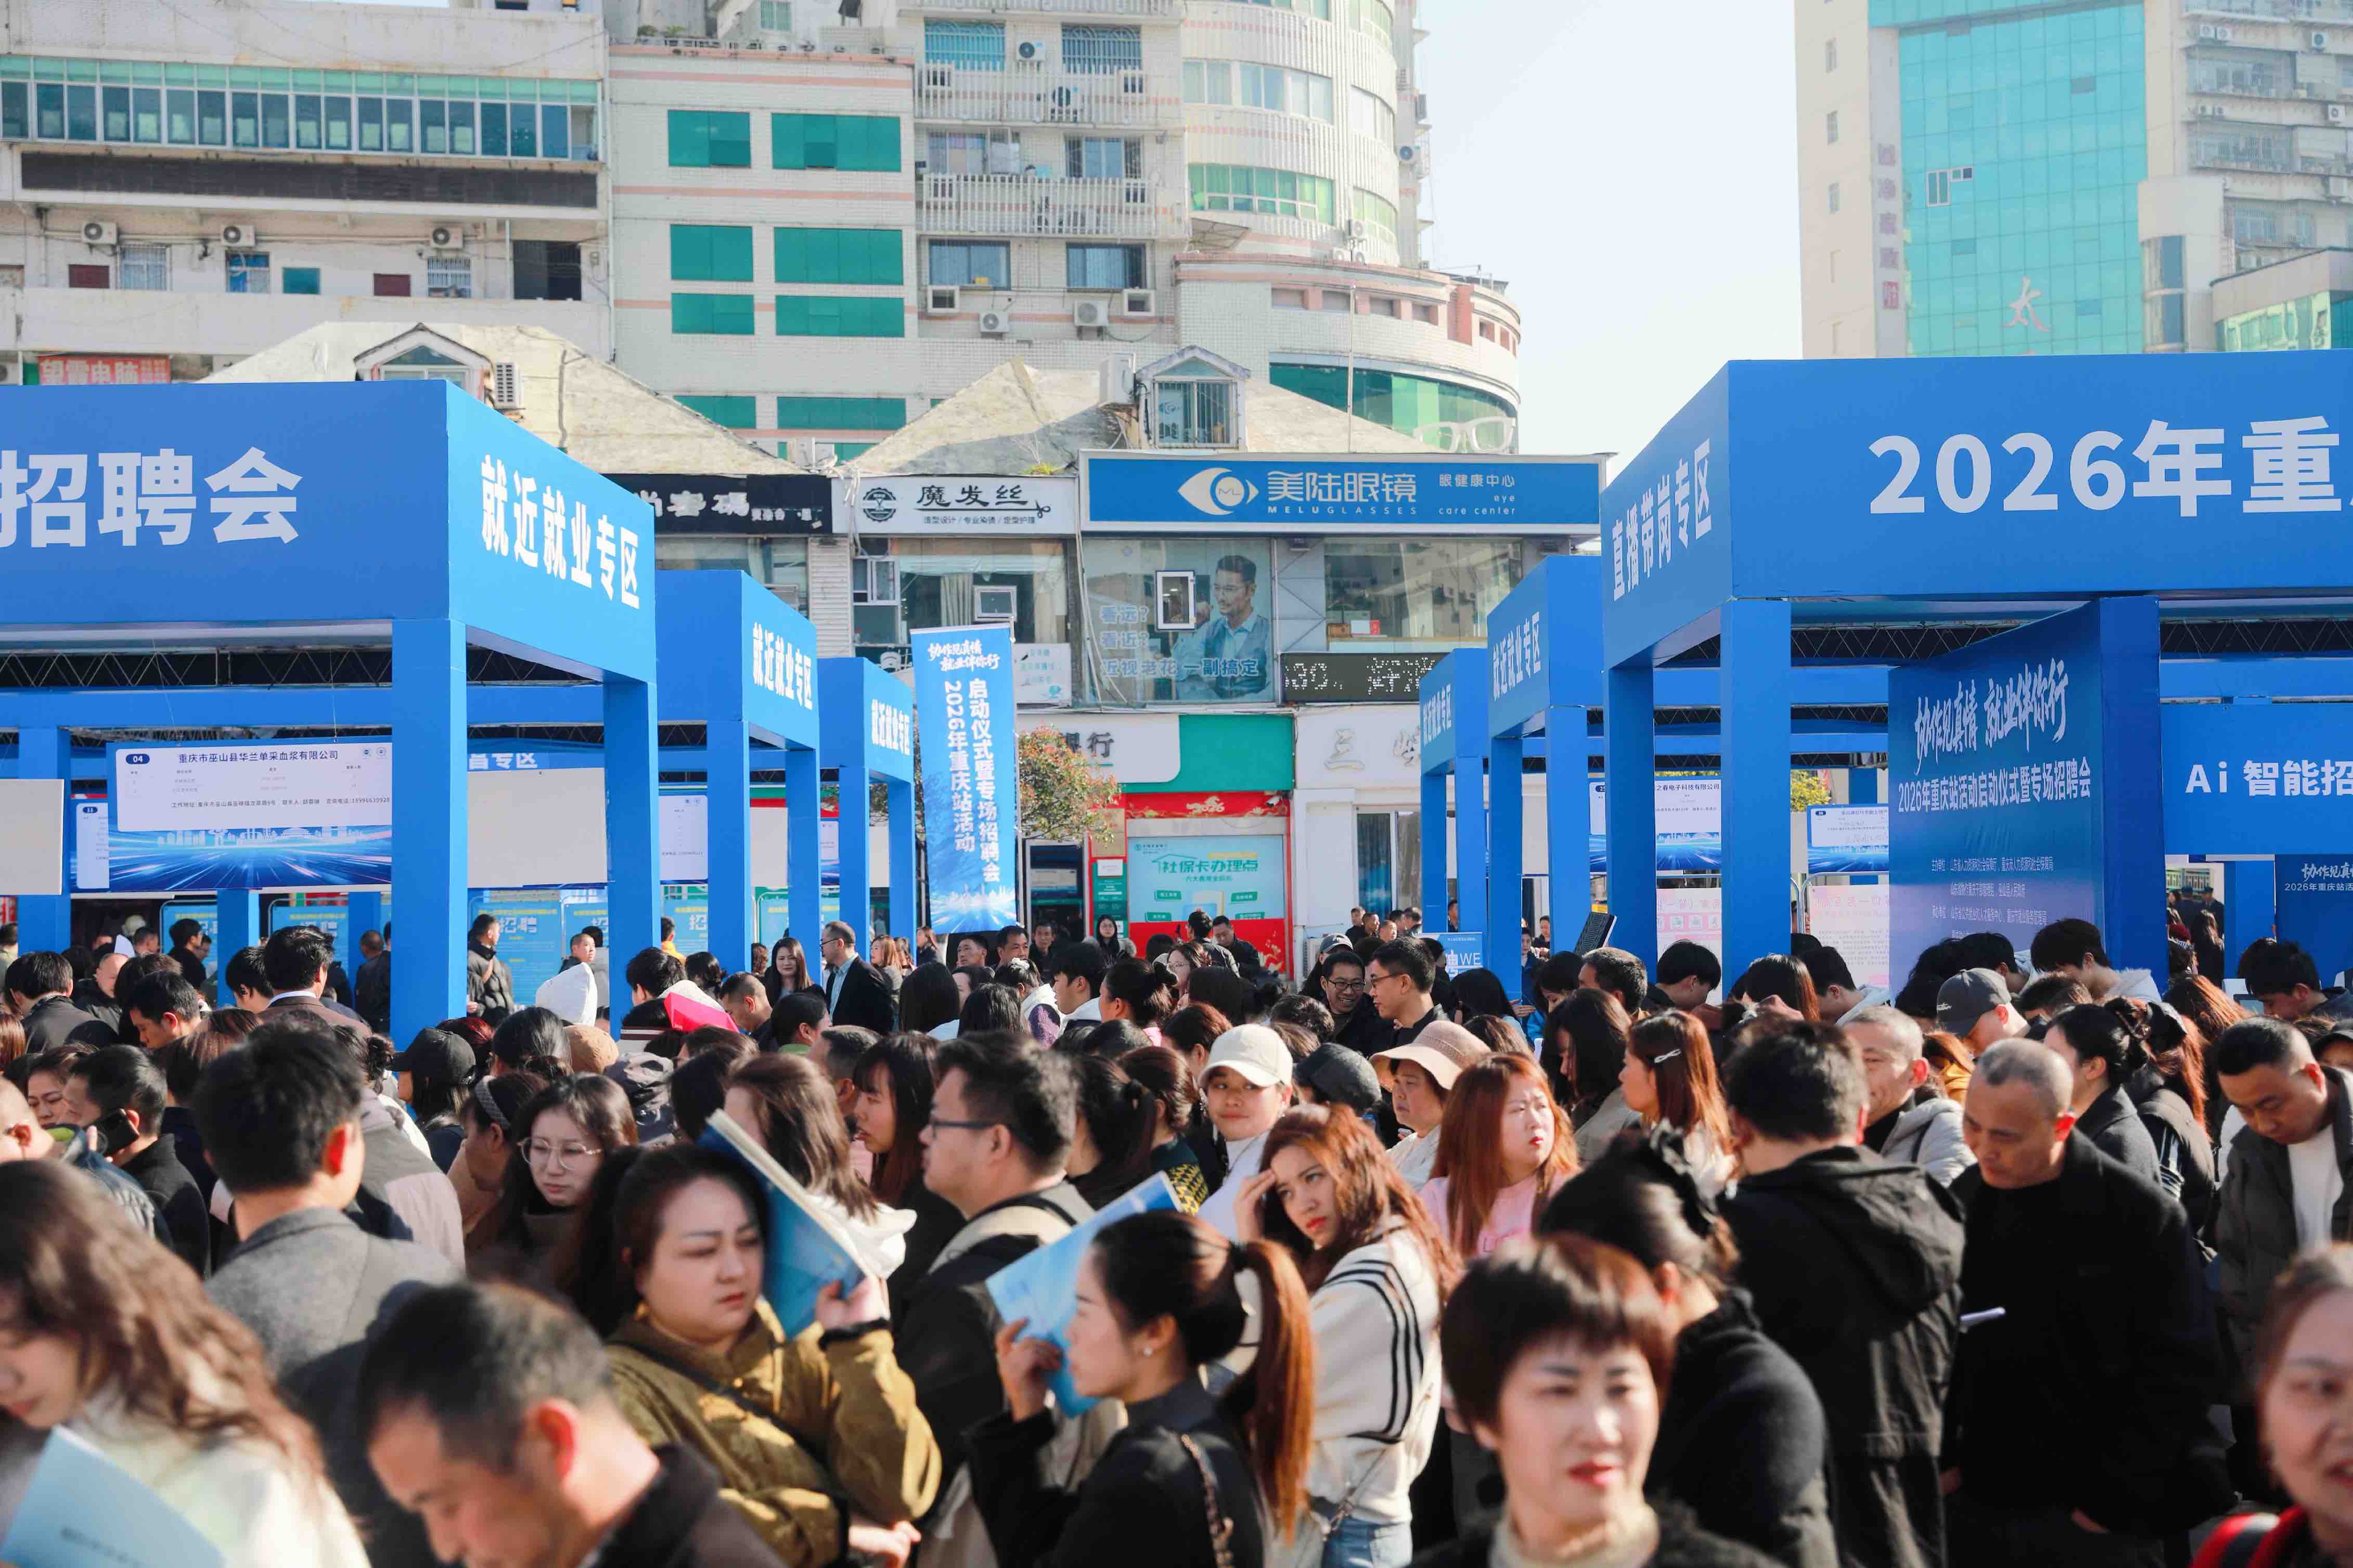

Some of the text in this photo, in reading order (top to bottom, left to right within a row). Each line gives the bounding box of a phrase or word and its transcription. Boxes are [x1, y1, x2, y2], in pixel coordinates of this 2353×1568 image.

[1267, 471, 1416, 503] 美陆眼镜
[1439, 474, 1515, 487] 眼健康中心
[1868, 416, 2353, 517] 2026年重
[0, 446, 303, 548] 招聘会
[917, 485, 1028, 507] 魔发丝
[1268, 506, 1416, 514] MELUGLASSES
[1474, 507, 1515, 515] center
[1494, 495, 1515, 503] eye
[481, 454, 640, 610] 就近就业专区
[1612, 437, 1712, 602] 直播带岗专区
[752, 621, 813, 710] 就近就业专区
[1183, 658, 1259, 677] 一副搞定
[1493, 612, 1541, 702] 就近就业专区
[871, 698, 910, 756] 就近就业专区
[1423, 683, 1451, 748] 就近就业专区
[178, 749, 339, 763] 重庆市巫山县华兰单采血浆有限公司
[945, 680, 976, 853] 2026年重庆站活动
[2185, 759, 2353, 796] Ai 智能招
[968, 678, 1001, 883] 启动仪式暨专场招聘会
[1898, 757, 2091, 813] 2026年重庆站活动启动仪式暨专场招聘会
[1163, 860, 1259, 873] 社保卡办理点
[2301, 862, 2353, 883] 协作见真
